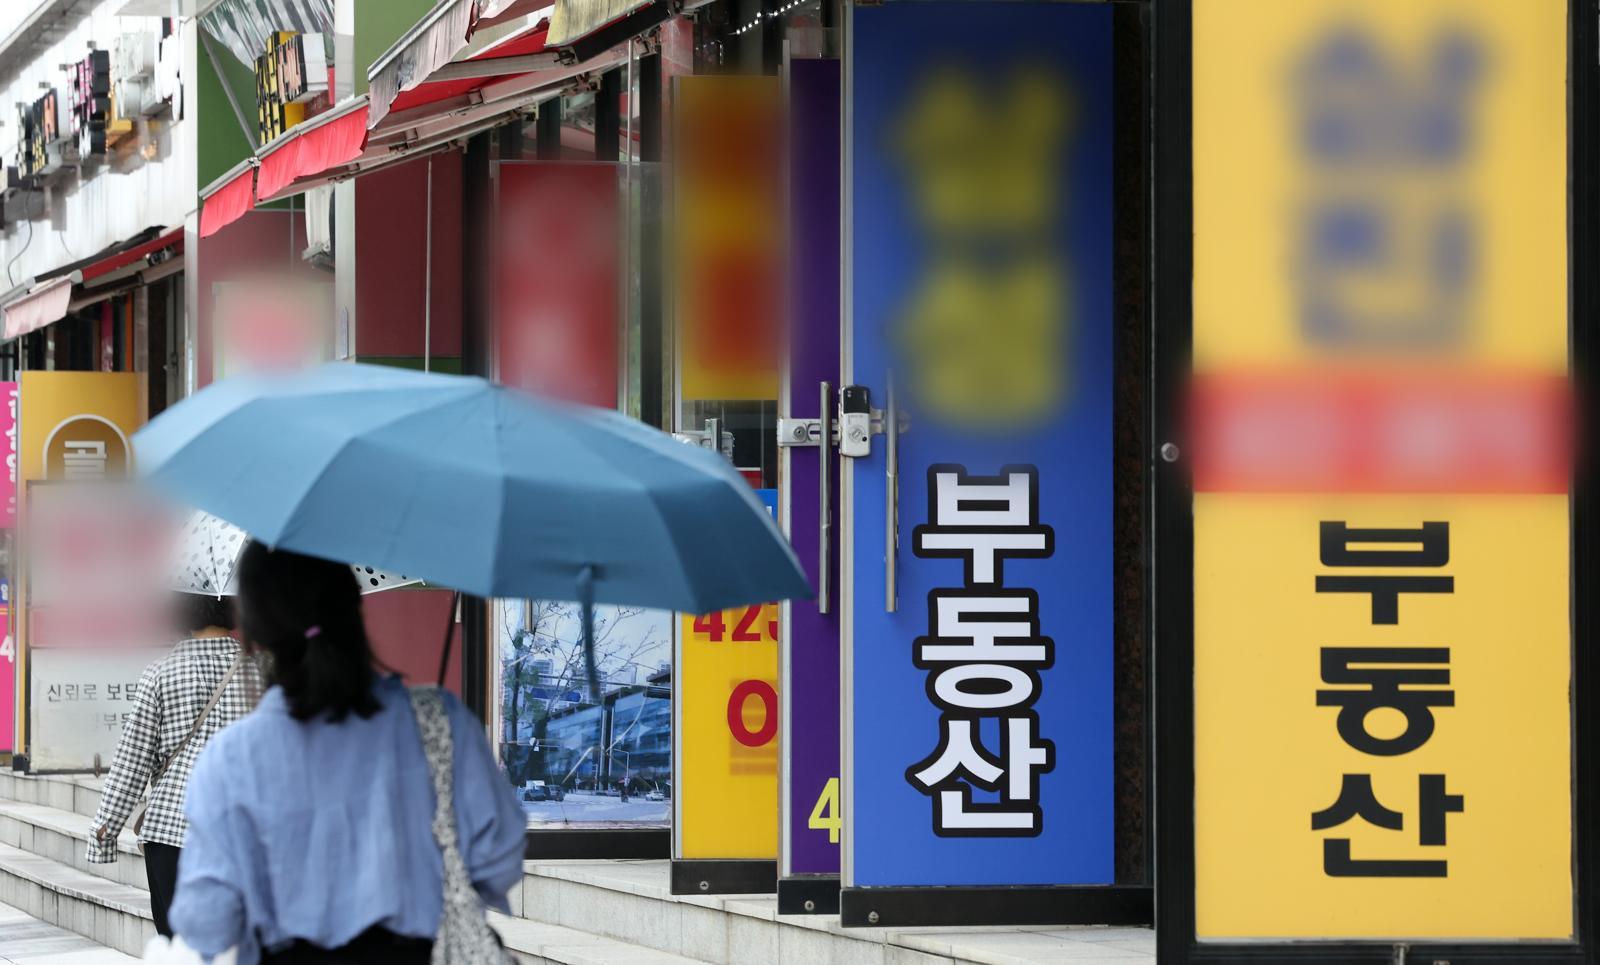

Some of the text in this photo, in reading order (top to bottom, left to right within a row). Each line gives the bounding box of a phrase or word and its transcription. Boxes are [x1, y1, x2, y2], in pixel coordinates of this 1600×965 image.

[808, 777, 841, 843] 4
[912, 471, 1048, 830] 부동산
[1311, 520, 1465, 878] 부동산
